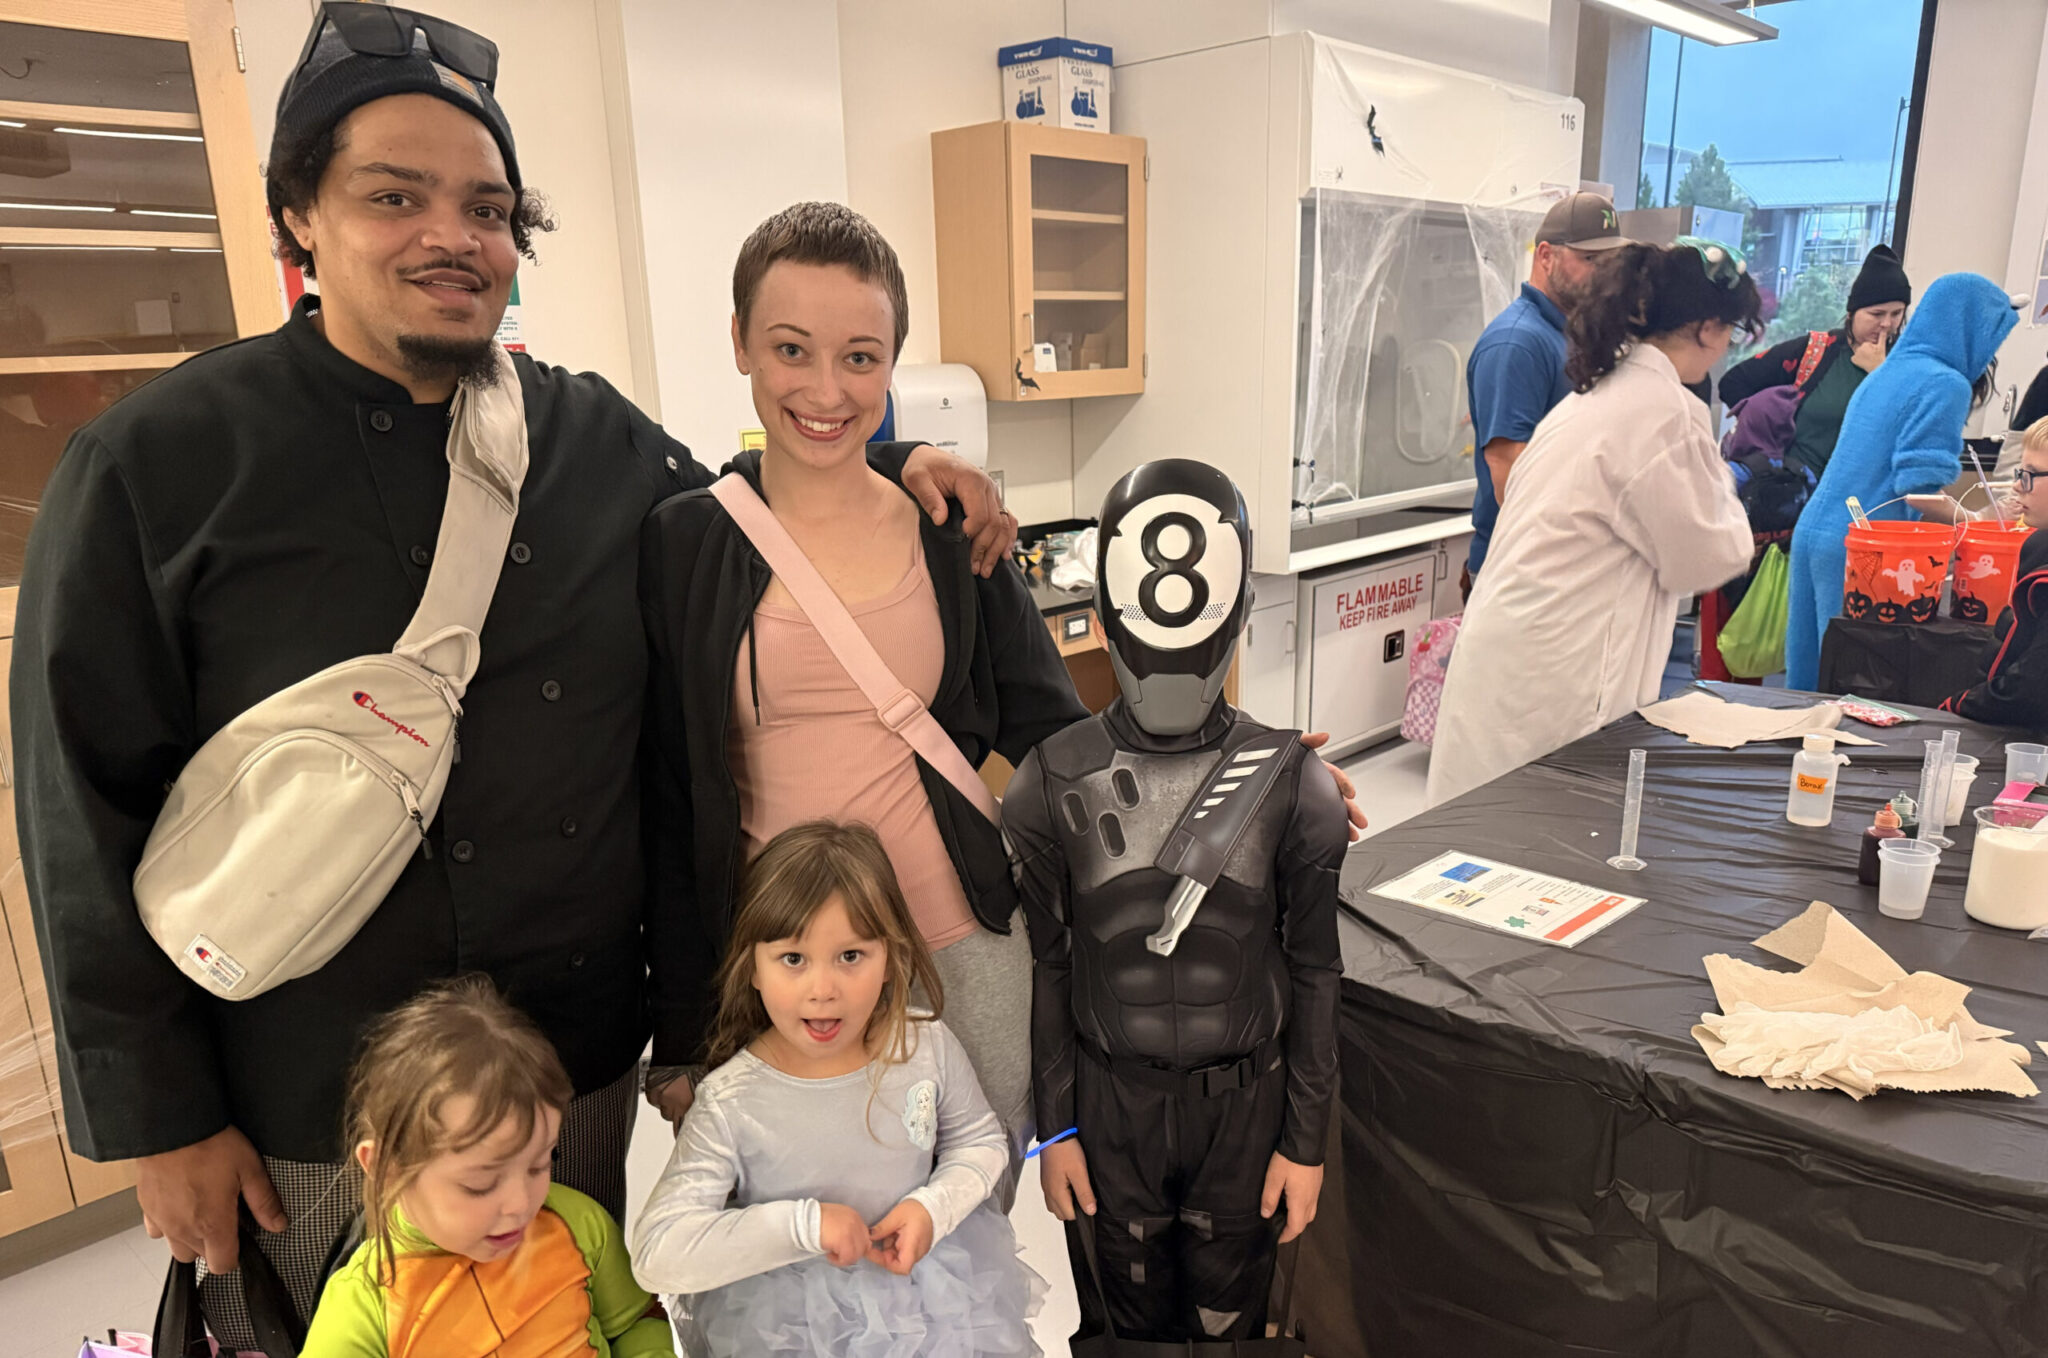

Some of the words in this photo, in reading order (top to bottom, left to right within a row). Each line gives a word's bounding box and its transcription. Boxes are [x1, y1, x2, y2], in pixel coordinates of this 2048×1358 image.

[1015, 66, 1040, 80] GLASS
[1071, 66, 1093, 78] GLASS
[1561, 113, 1576, 131] 116
[1138, 512, 1209, 628] 8
[1336, 573, 1424, 614] FLAMMABLE
[1339, 609, 1366, 631] KEEP
[1366, 602, 1390, 623] FIRE
[1391, 595, 1418, 617] AWAY
[352, 690, 431, 747] Champion
[1800, 777, 1823, 790] Borax
